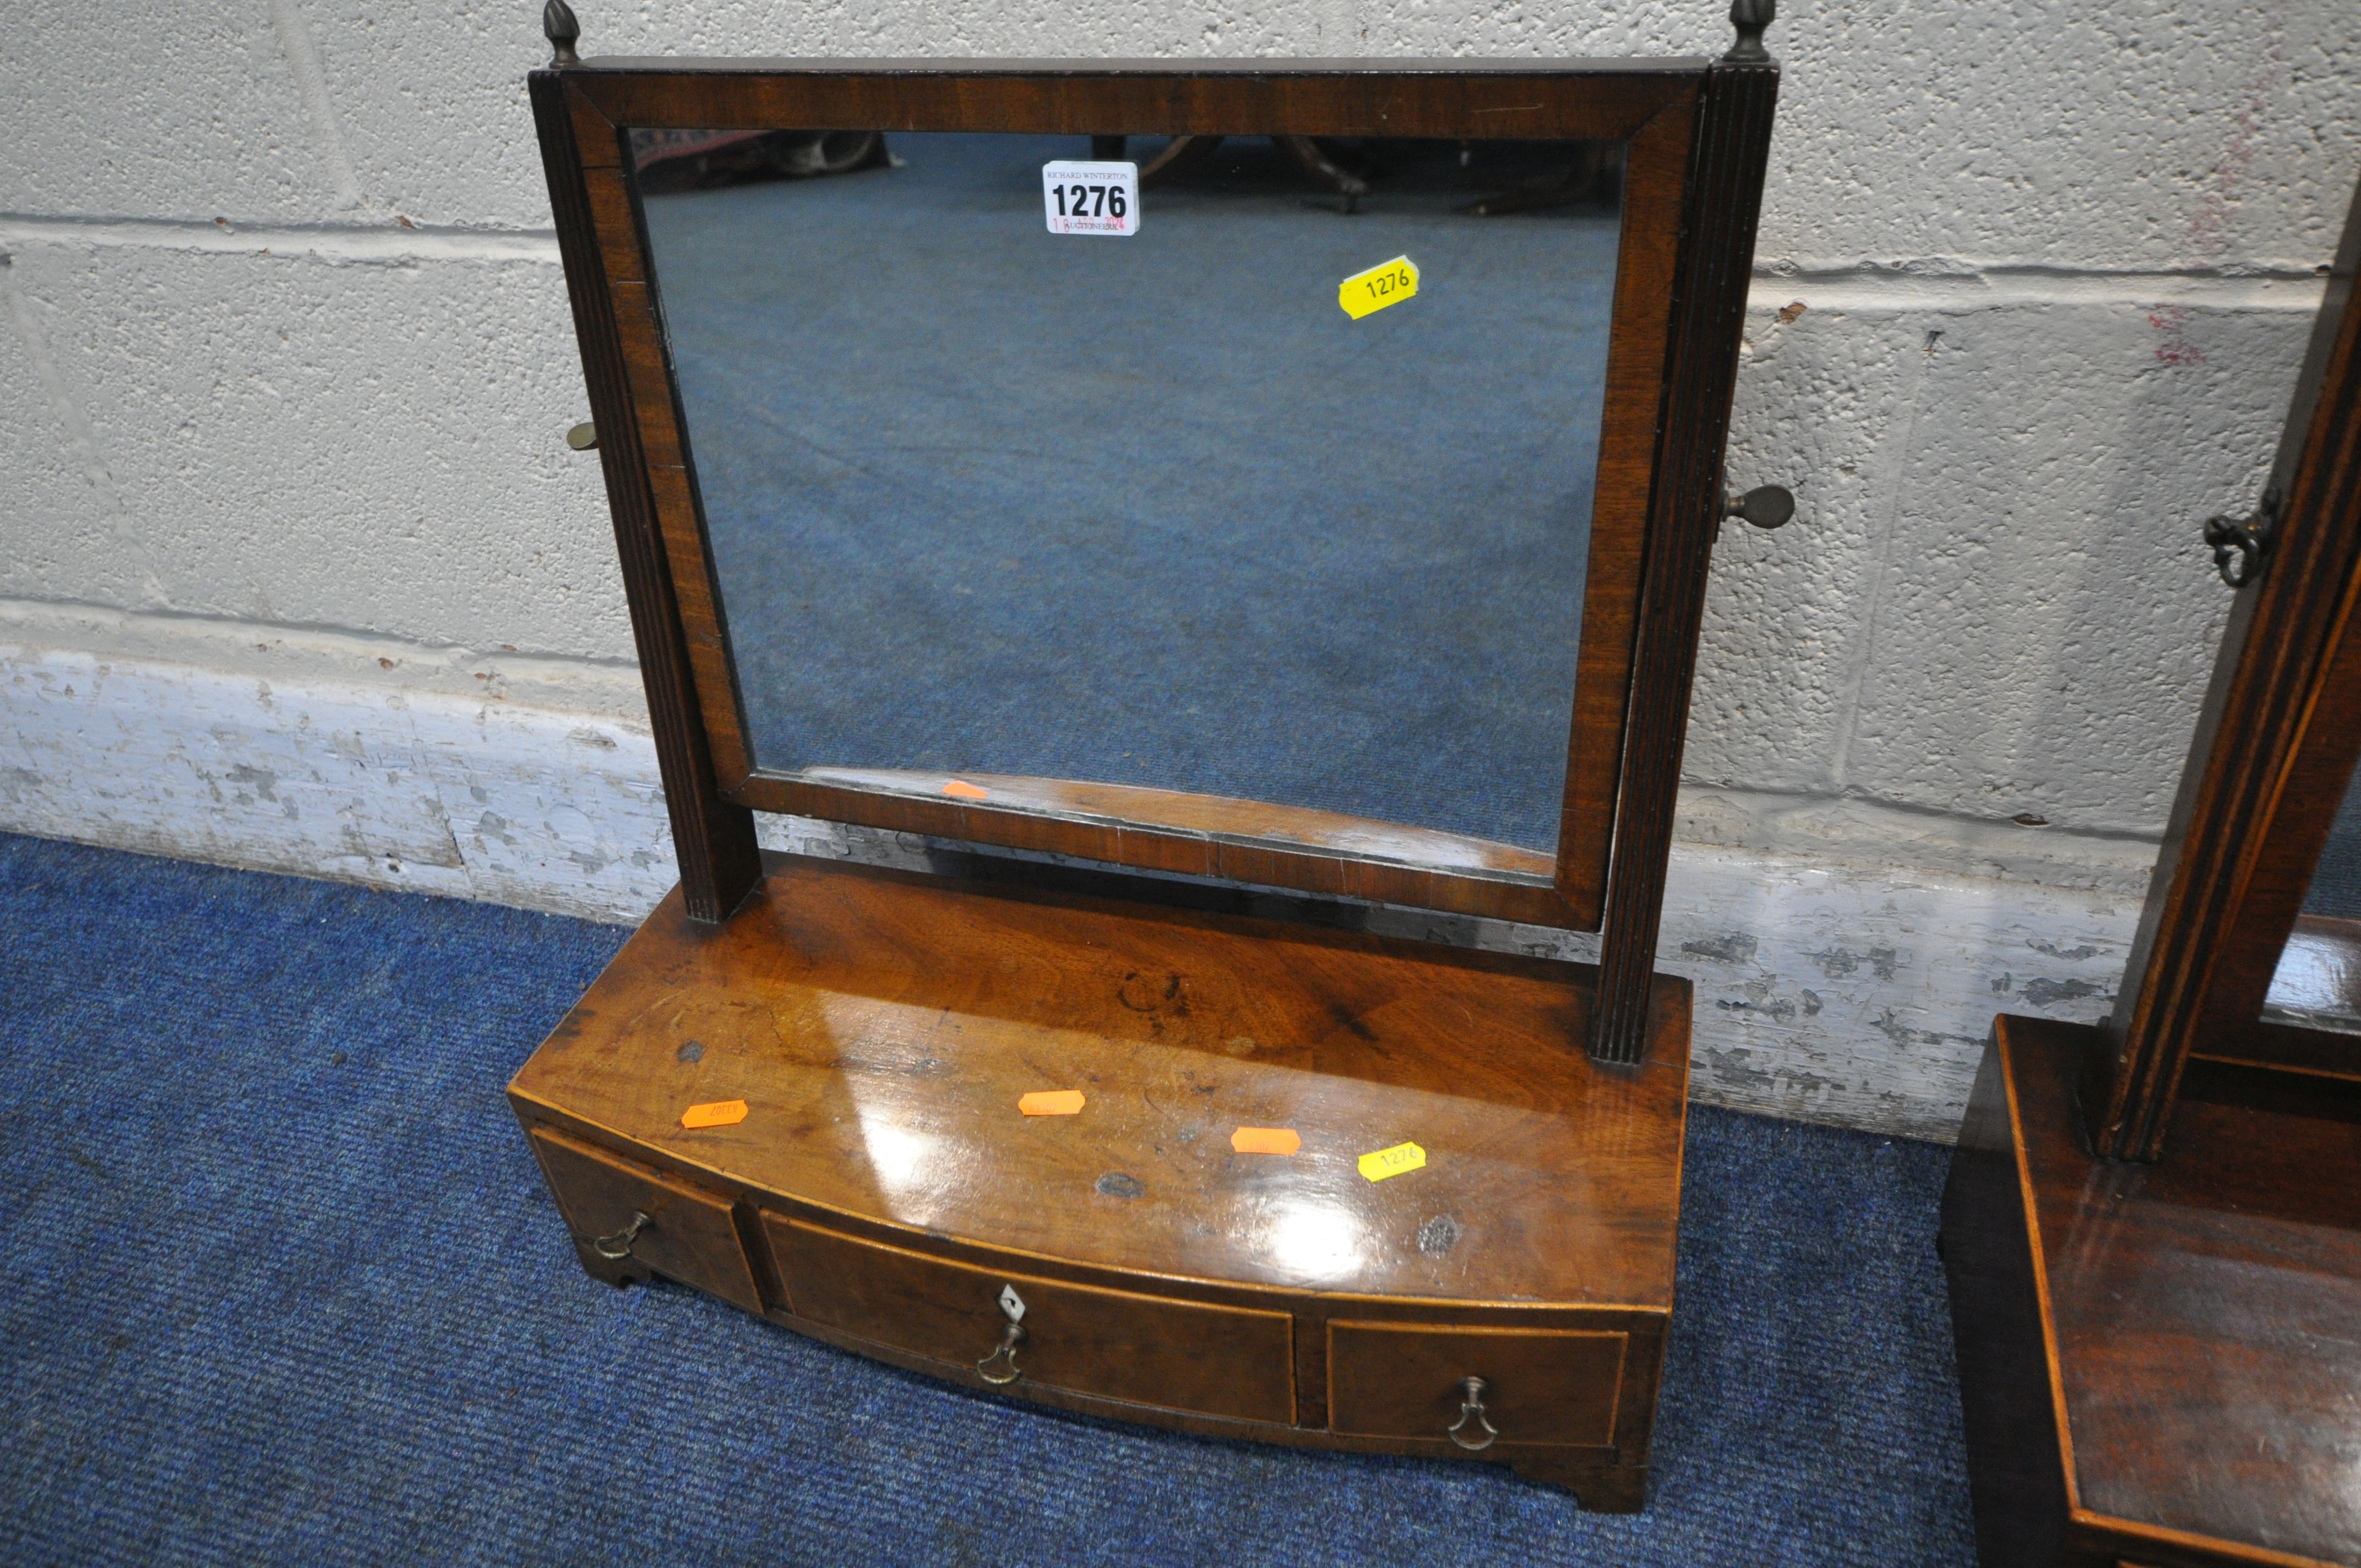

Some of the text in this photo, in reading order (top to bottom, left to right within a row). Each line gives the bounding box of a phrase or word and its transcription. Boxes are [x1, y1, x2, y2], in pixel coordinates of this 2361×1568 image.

[1053, 184, 1127, 218] 1276
[1366, 269, 1410, 298] 1276
[710, 1104, 738, 1116] A3307
[1029, 1103, 1057, 1113] A3307
[1381, 1147, 1419, 1166] 1276
